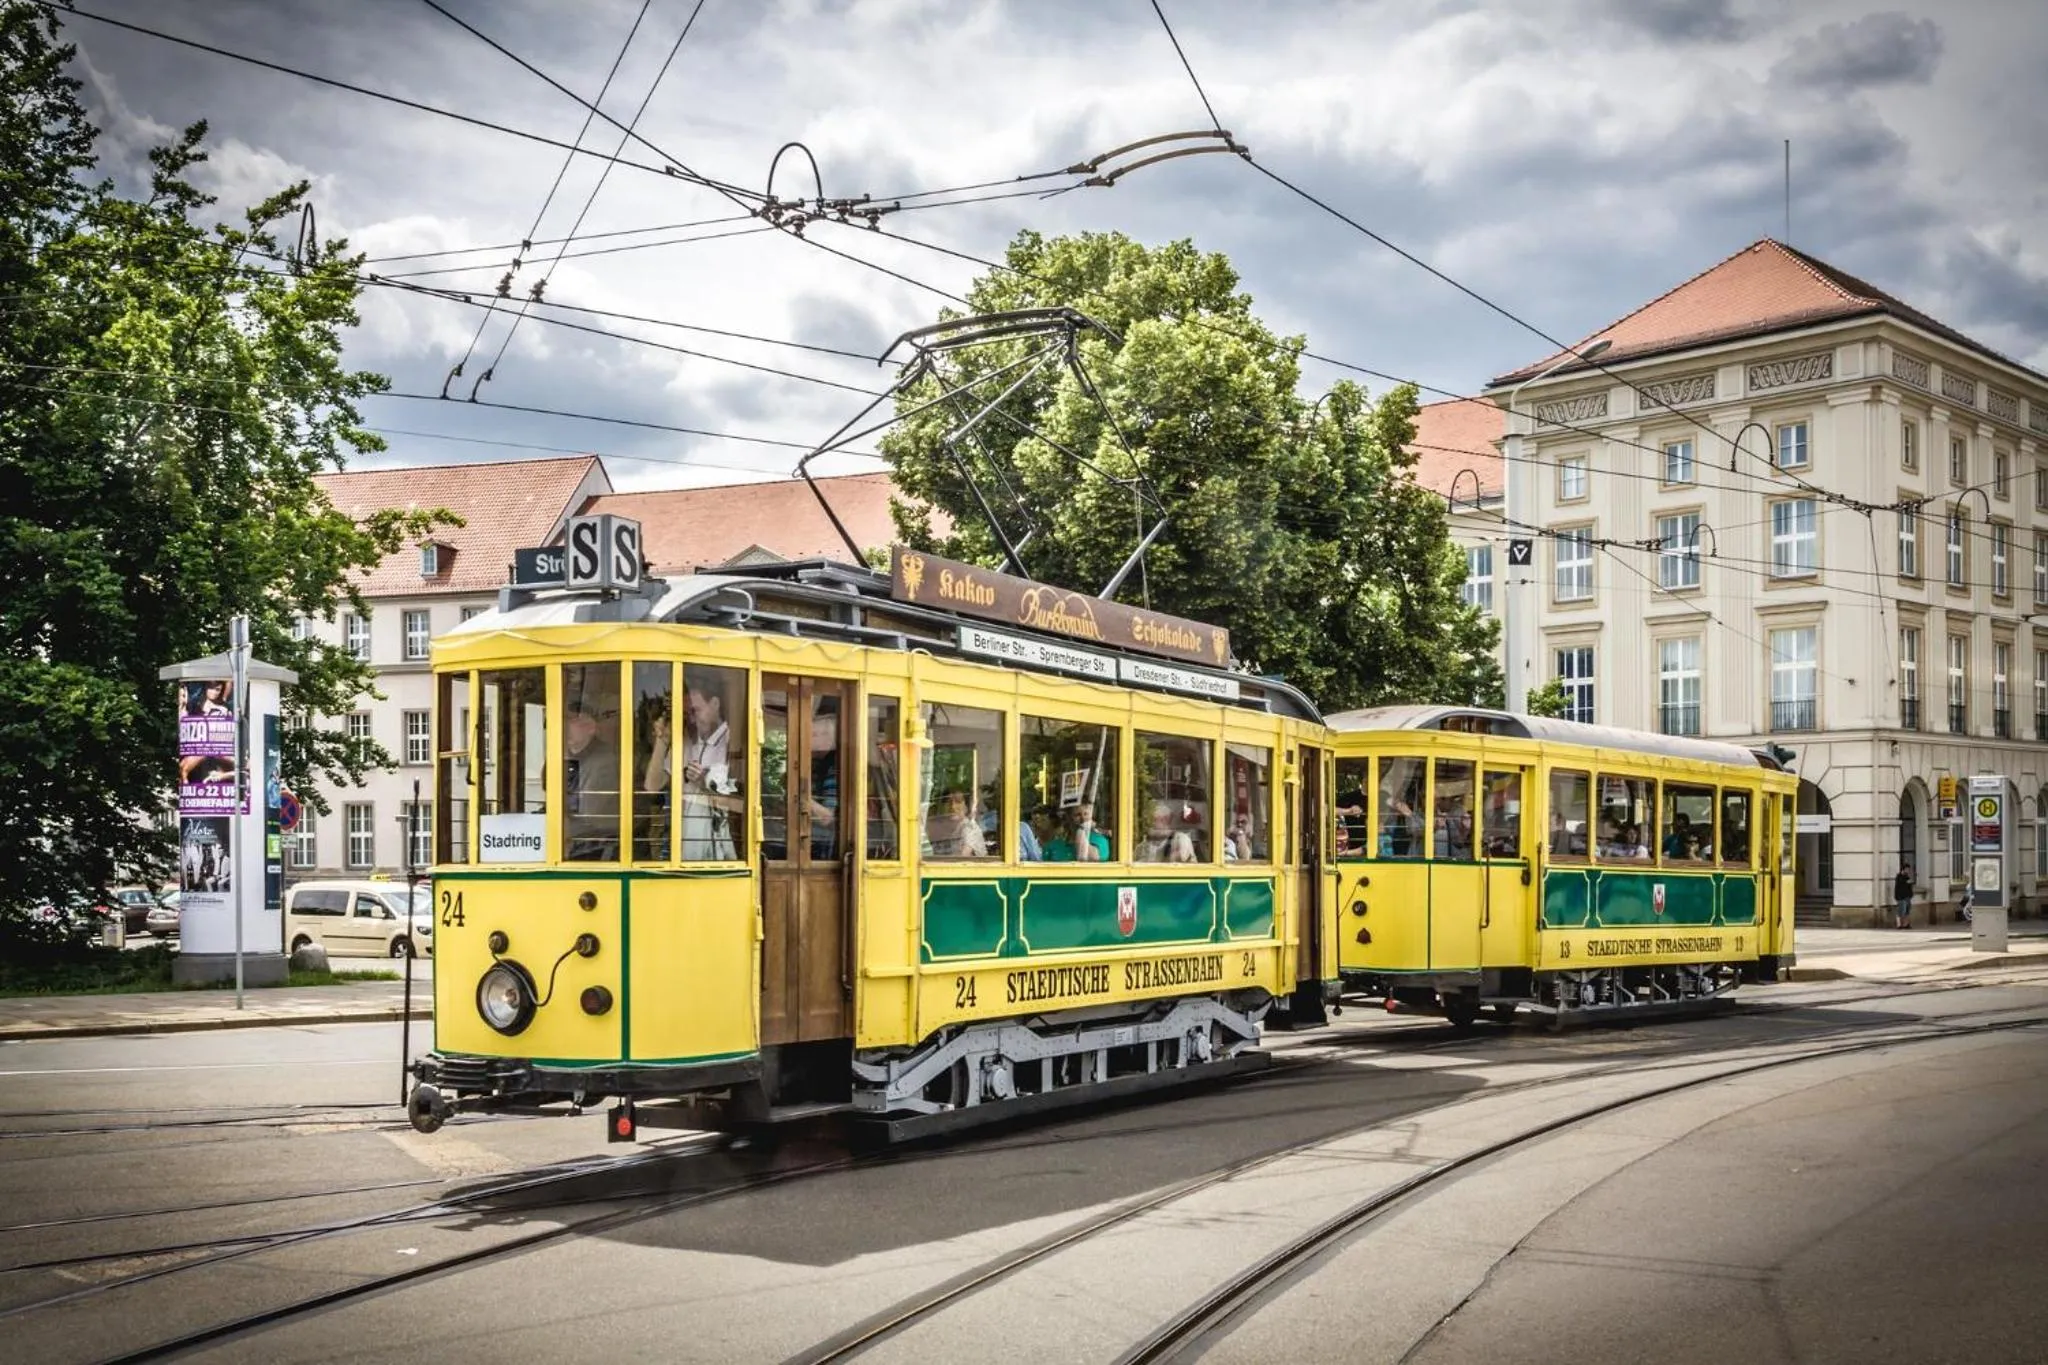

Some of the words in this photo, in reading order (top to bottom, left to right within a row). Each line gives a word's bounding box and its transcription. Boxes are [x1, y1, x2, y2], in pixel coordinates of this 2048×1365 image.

[572, 522, 599, 580] S
[615, 524, 637, 583] S
[939, 568, 995, 606] Kakao
[1132, 616, 1202, 653] Schokolade
[973, 633, 1011, 653] Berliner
[1012, 641, 1027, 657] Str.
[1039, 646, 1092, 671] Spremberger
[1093, 658, 1106, 673] Str.
[1984, 803, 1992, 813] H
[483, 833, 542, 850] Stadtring
[441, 890, 465, 927] 24
[1559, 939, 1571, 959] 13
[1587, 938, 1653, 957] STAEDTISCHE
[1655, 936, 1723, 955] STRASSENBAHN
[955, 975, 977, 1009] 24
[1006, 964, 1110, 1003] STAEDTISCHE
[1125, 954, 1224, 990] STRASSENBAHN
[1242, 952, 1256, 977] 24
